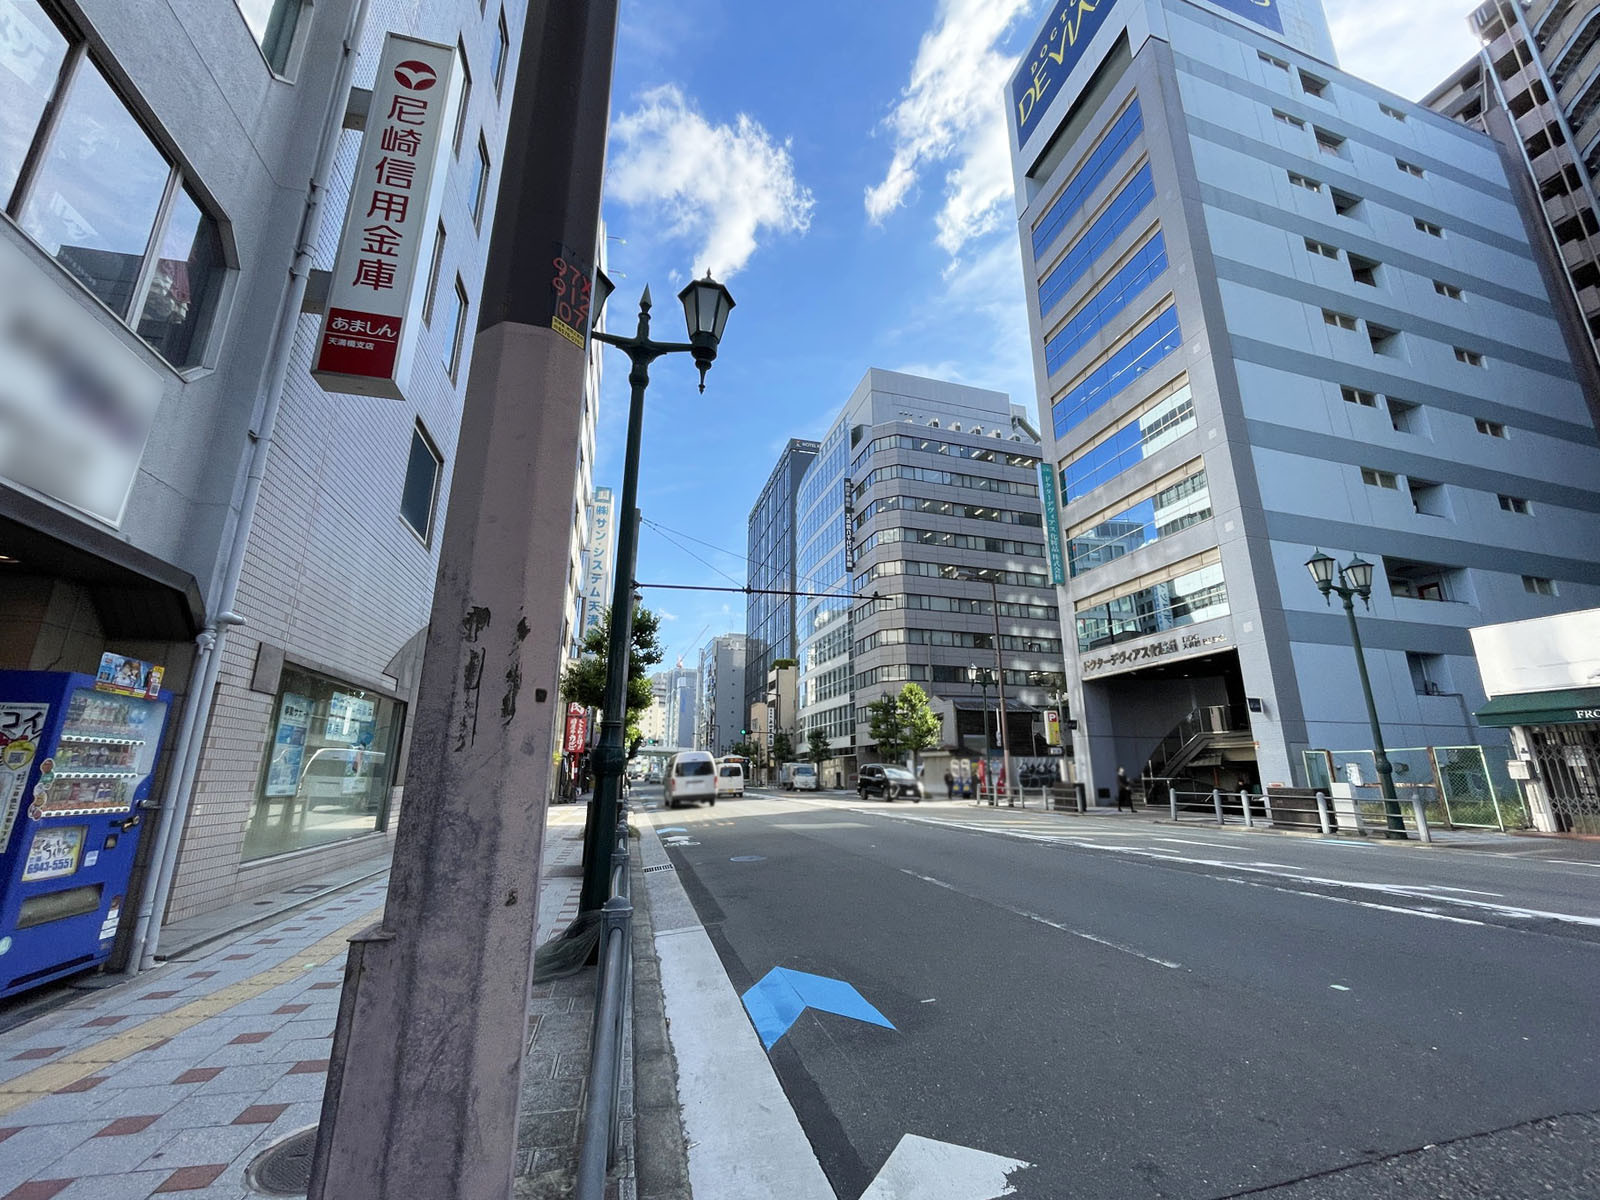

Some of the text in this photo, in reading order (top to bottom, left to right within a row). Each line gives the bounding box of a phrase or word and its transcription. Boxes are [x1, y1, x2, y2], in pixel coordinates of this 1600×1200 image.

[1019, 0, 1099, 127] DEVIA
[352, 94, 428, 291] 尼崎信用金庫
[328, 336, 375, 351] 天満橋支店
[331, 316, 397, 338] あましん
